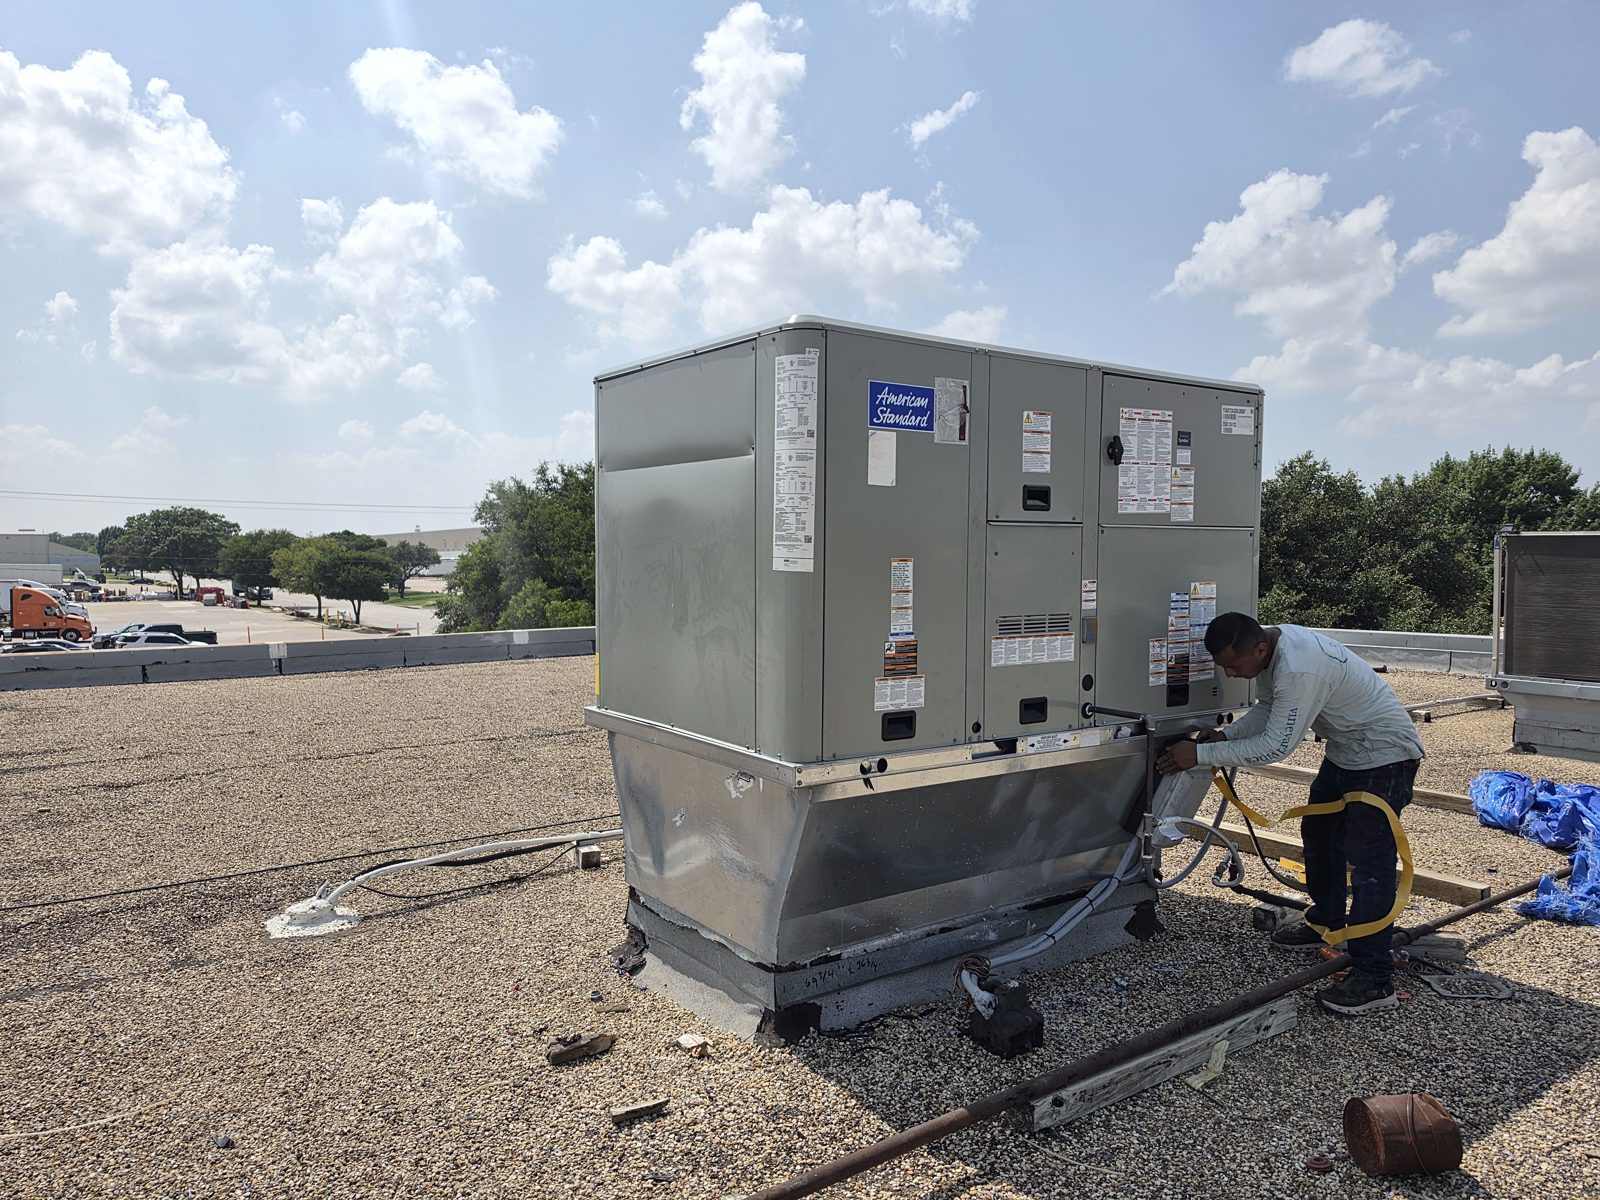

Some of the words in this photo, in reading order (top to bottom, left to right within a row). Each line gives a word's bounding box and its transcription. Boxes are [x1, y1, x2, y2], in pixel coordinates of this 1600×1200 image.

[875, 386, 929, 409] American
[873, 406, 930, 428] Standard
[1276, 707, 1298, 755] vineyard
